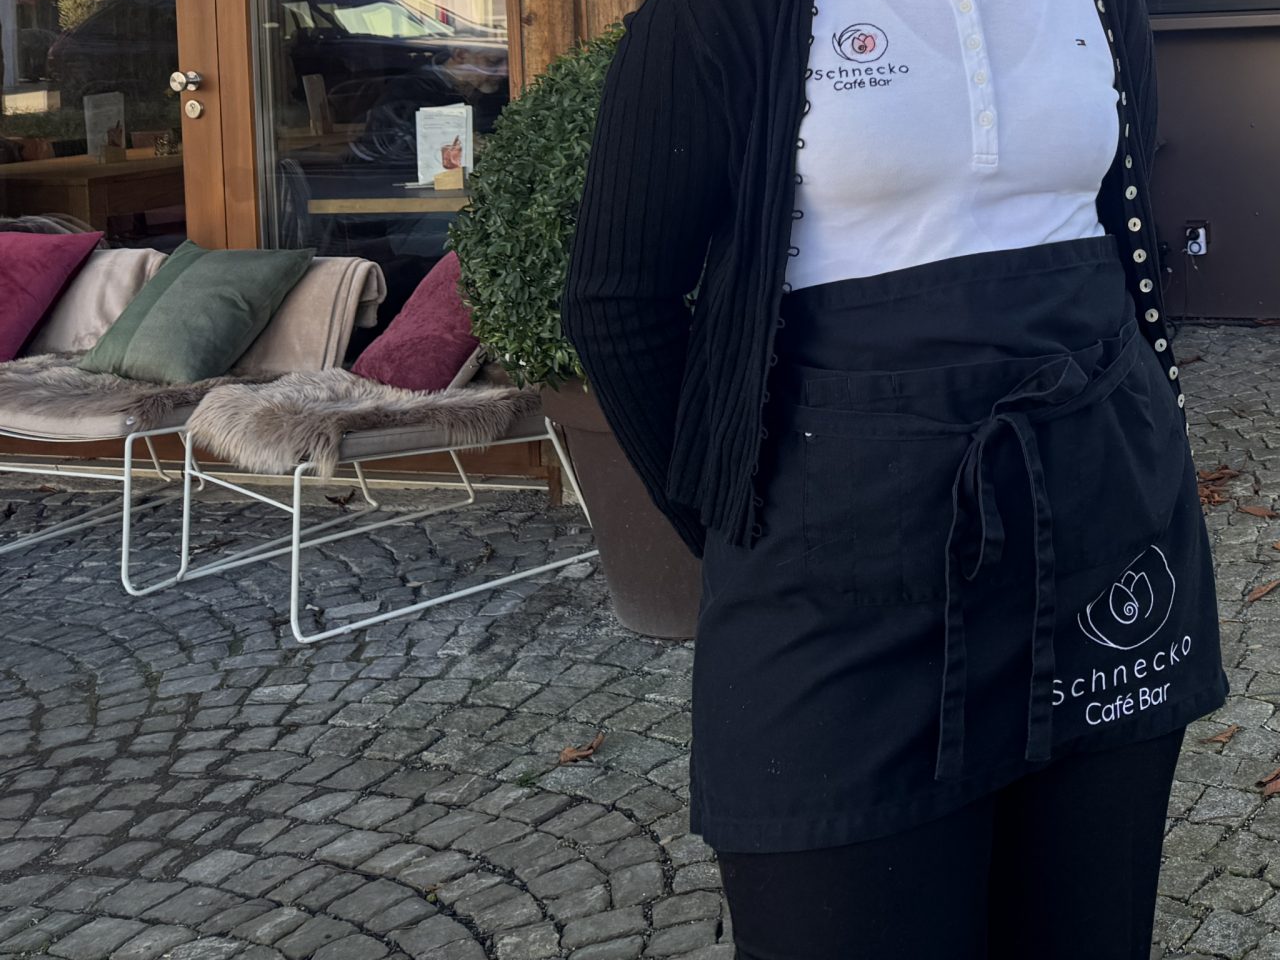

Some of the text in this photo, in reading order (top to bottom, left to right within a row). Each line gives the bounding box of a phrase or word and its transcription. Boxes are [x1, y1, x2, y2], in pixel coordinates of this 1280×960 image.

[814, 63, 909, 81] schnecko
[833, 76, 893, 91] Café Bar
[1085, 682, 1171, 726] Café Bar
